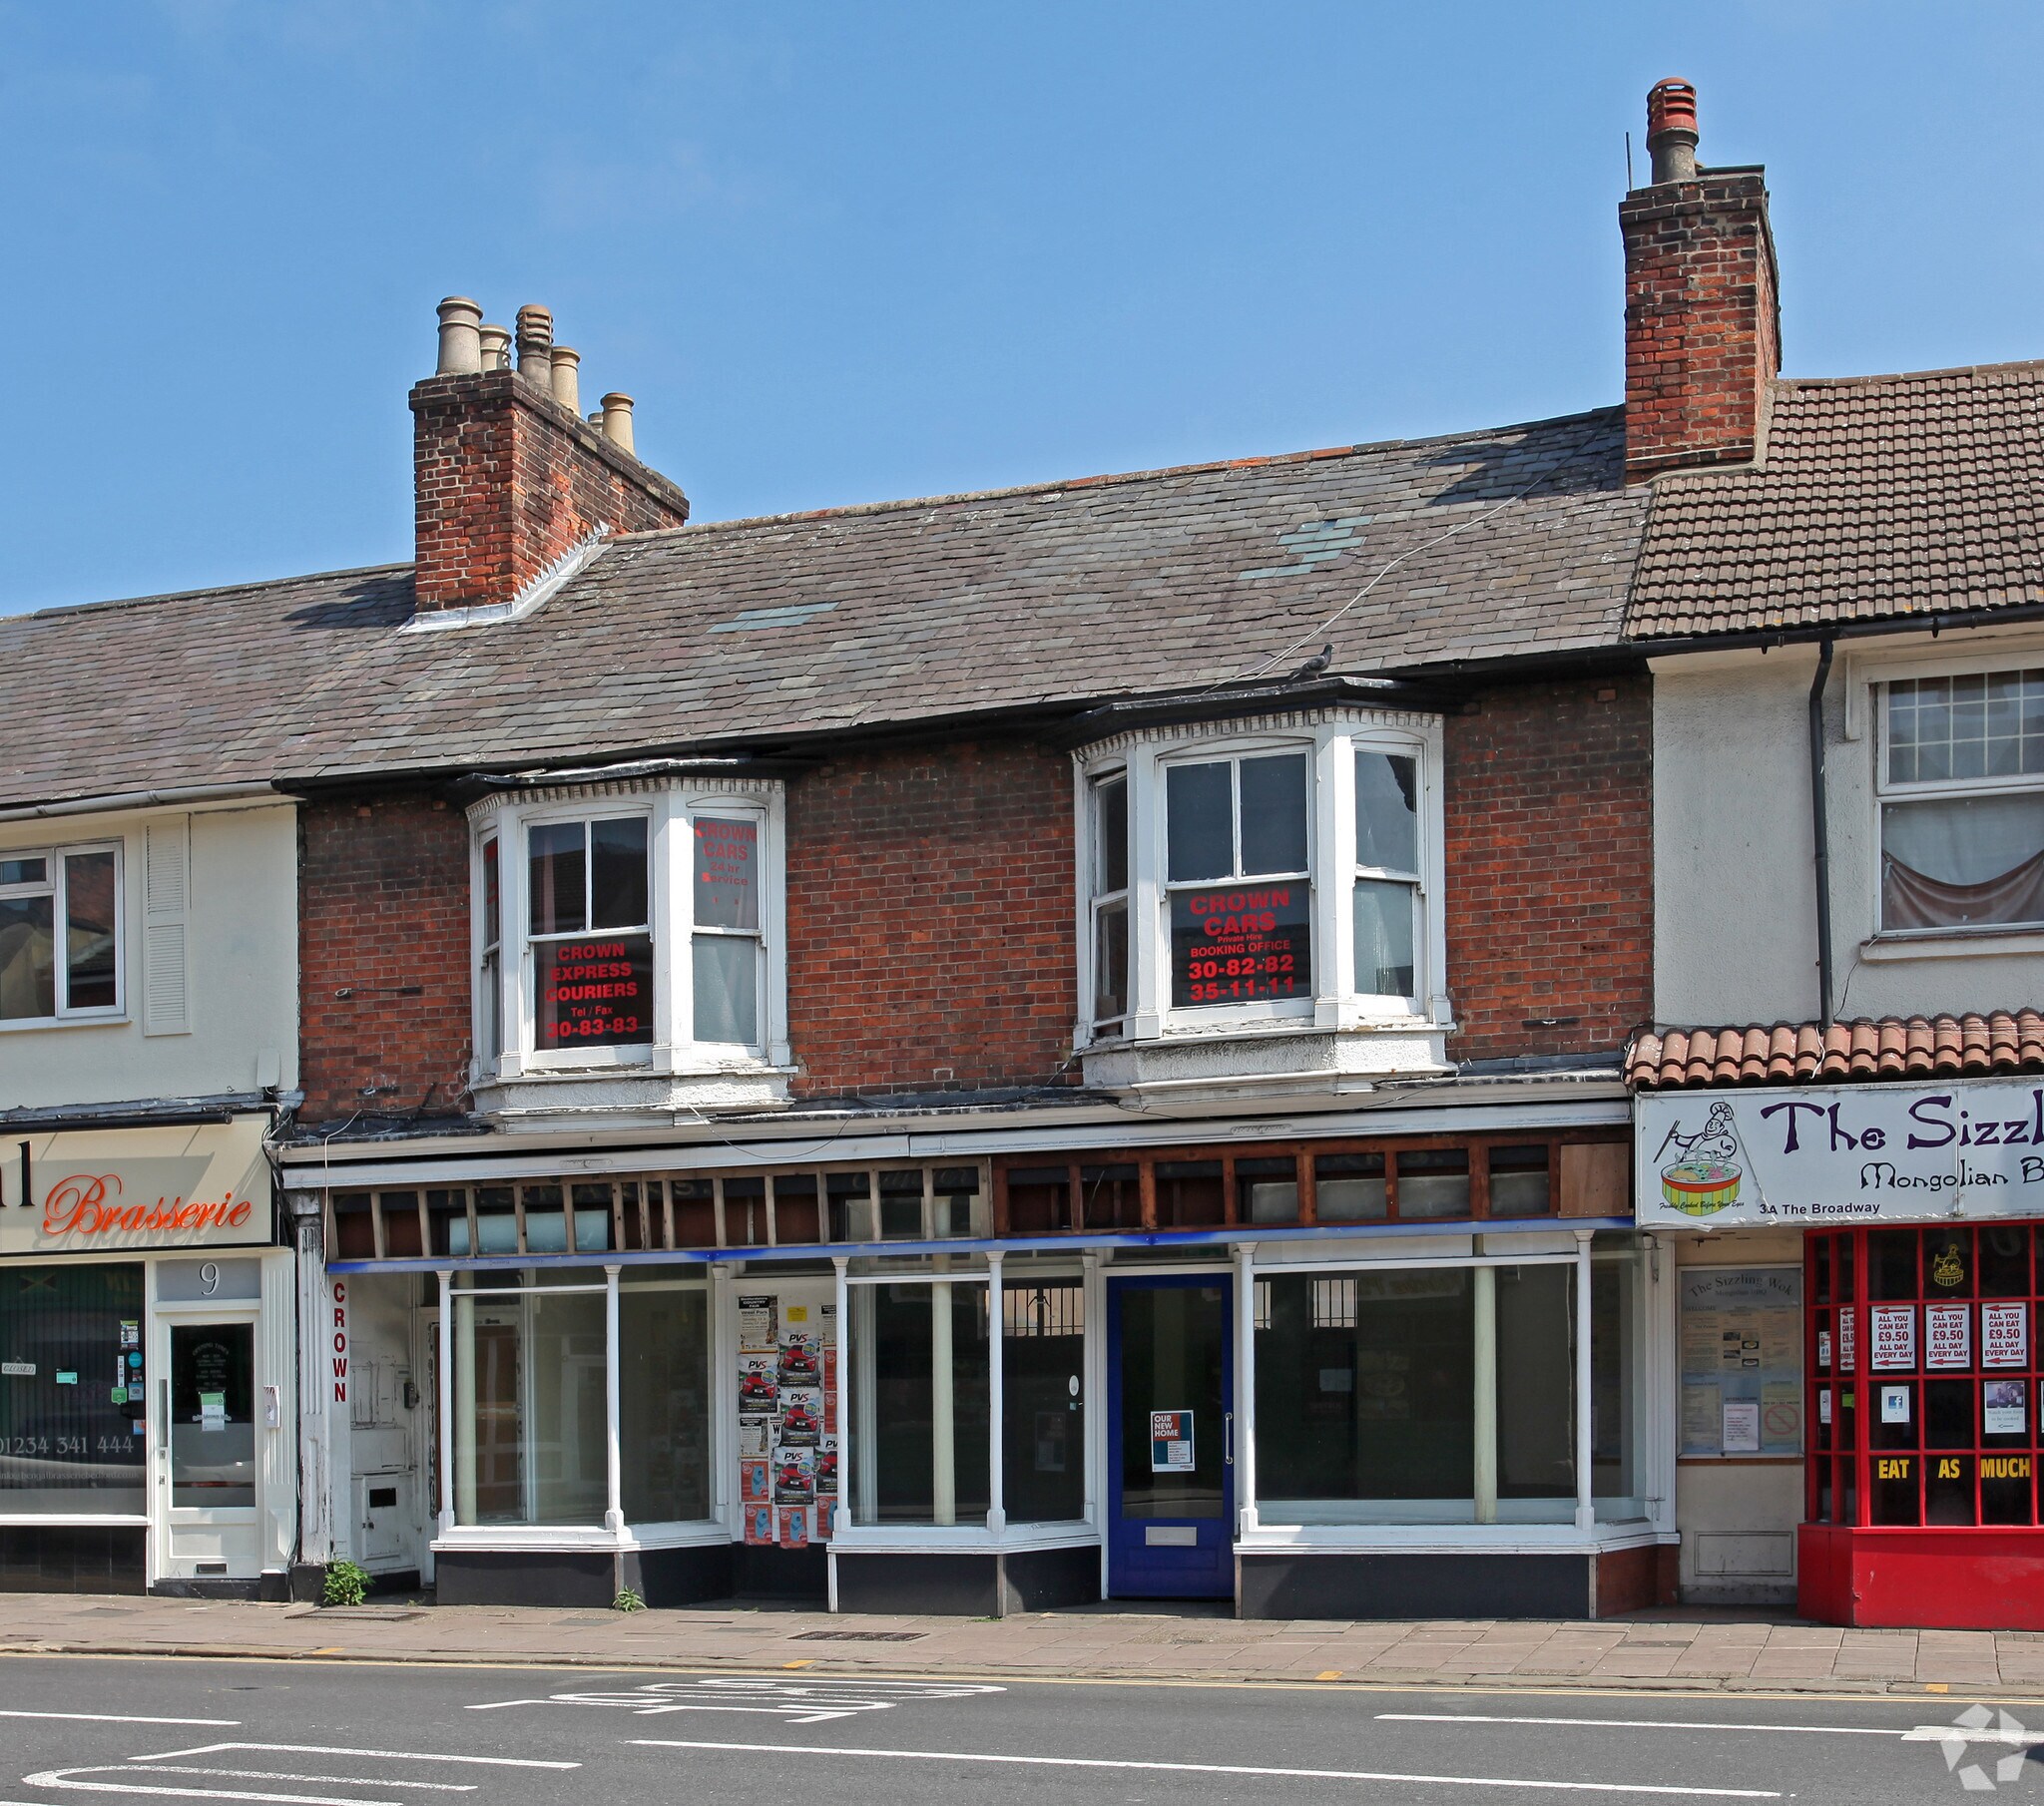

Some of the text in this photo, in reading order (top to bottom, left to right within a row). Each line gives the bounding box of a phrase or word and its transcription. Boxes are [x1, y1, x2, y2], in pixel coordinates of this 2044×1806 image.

[695, 821, 758, 842] CROWN
[704, 840, 749, 861] CARS
[711, 861, 741, 873] 24 hr
[1190, 888, 1290, 915] CROWN
[1204, 912, 1277, 936] CARS
[559, 942, 626, 961] CROWN
[1190, 940, 1290, 958] BOOKING OFFICE
[550, 962, 632, 982] EXPRESS
[1189, 955, 1294, 980] 30-82-82
[546, 982, 638, 1002] COURIERS
[1190, 976, 1294, 1001] 35-11-11
[570, 1007, 586, 1017] Tel
[595, 1006, 614, 1015] Fax
[546, 1016, 638, 1038] 30-83-83
[1761, 1102, 1886, 1154] The
[1860, 1158, 2009, 1192] Mongolian
[0, 1140, 254, 1235] l Brasserie
[1700, 1200, 1716, 1209] Before
[1760, 1202, 1880, 1215] 3A The Broadway
[200, 1262, 220, 1295] 9
[1689, 1273, 1793, 1297] The Sizzling Wok
[332, 1282, 347, 1402] CROWN
[788, 1333, 808, 1343] PVS
[1842, 1333, 1854, 1343] £9.5
[1878, 1331, 1908, 1341] £9.50
[1933, 1330, 1963, 1340] £9.50
[1989, 1329, 2020, 1339] £9.50
[749, 1360, 767, 1370] PVS
[790, 1393, 809, 1402] PVS
[56, 1436, 88, 1454] 341
[98, 1435, 134, 1453] 444
[784, 1452, 803, 1462] PVS
[1878, 1458, 2031, 1479] EAT AS MUCH
